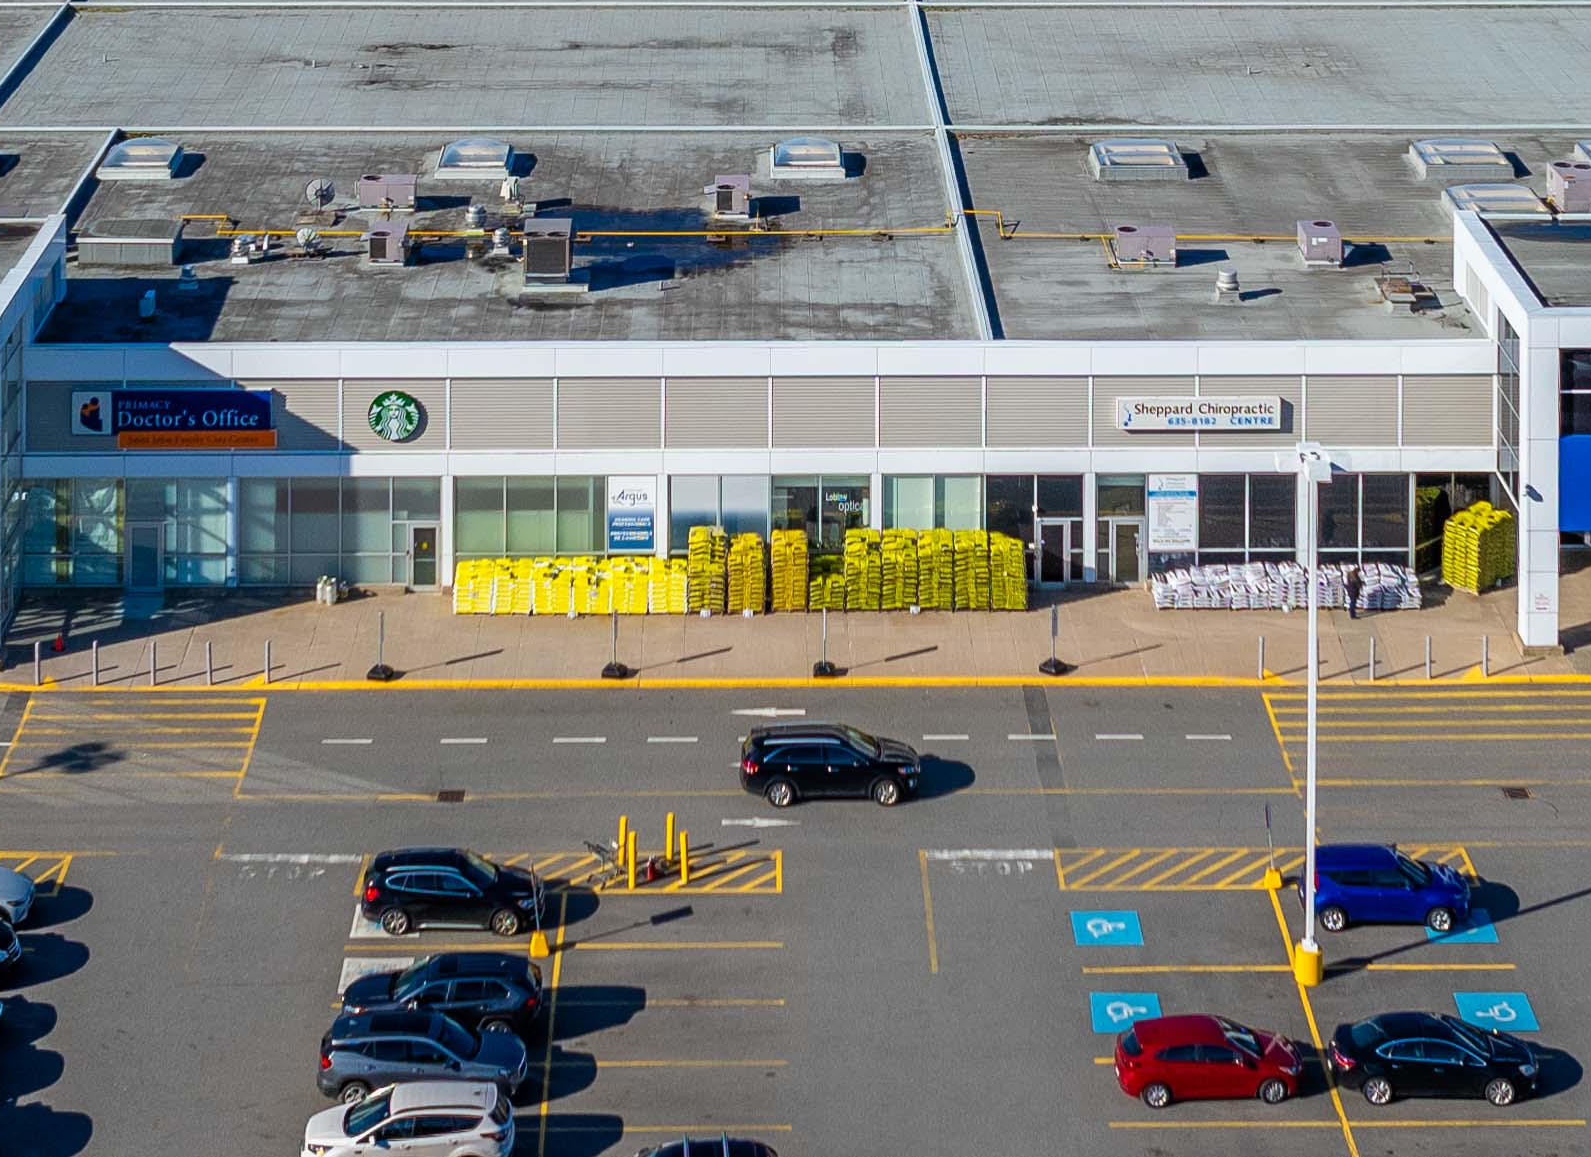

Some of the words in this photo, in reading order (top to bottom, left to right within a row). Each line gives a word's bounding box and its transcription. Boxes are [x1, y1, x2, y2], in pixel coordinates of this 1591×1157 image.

[118, 410, 196, 427] Doctor's
[202, 409, 259, 427] Office
[1134, 403, 1193, 418] Sheppard
[1198, 403, 1274, 418] Chiropractic
[1230, 417, 1273, 425] CENTRE
[616, 489, 648, 506] Argus
[951, 861, 1033, 875] STOP
